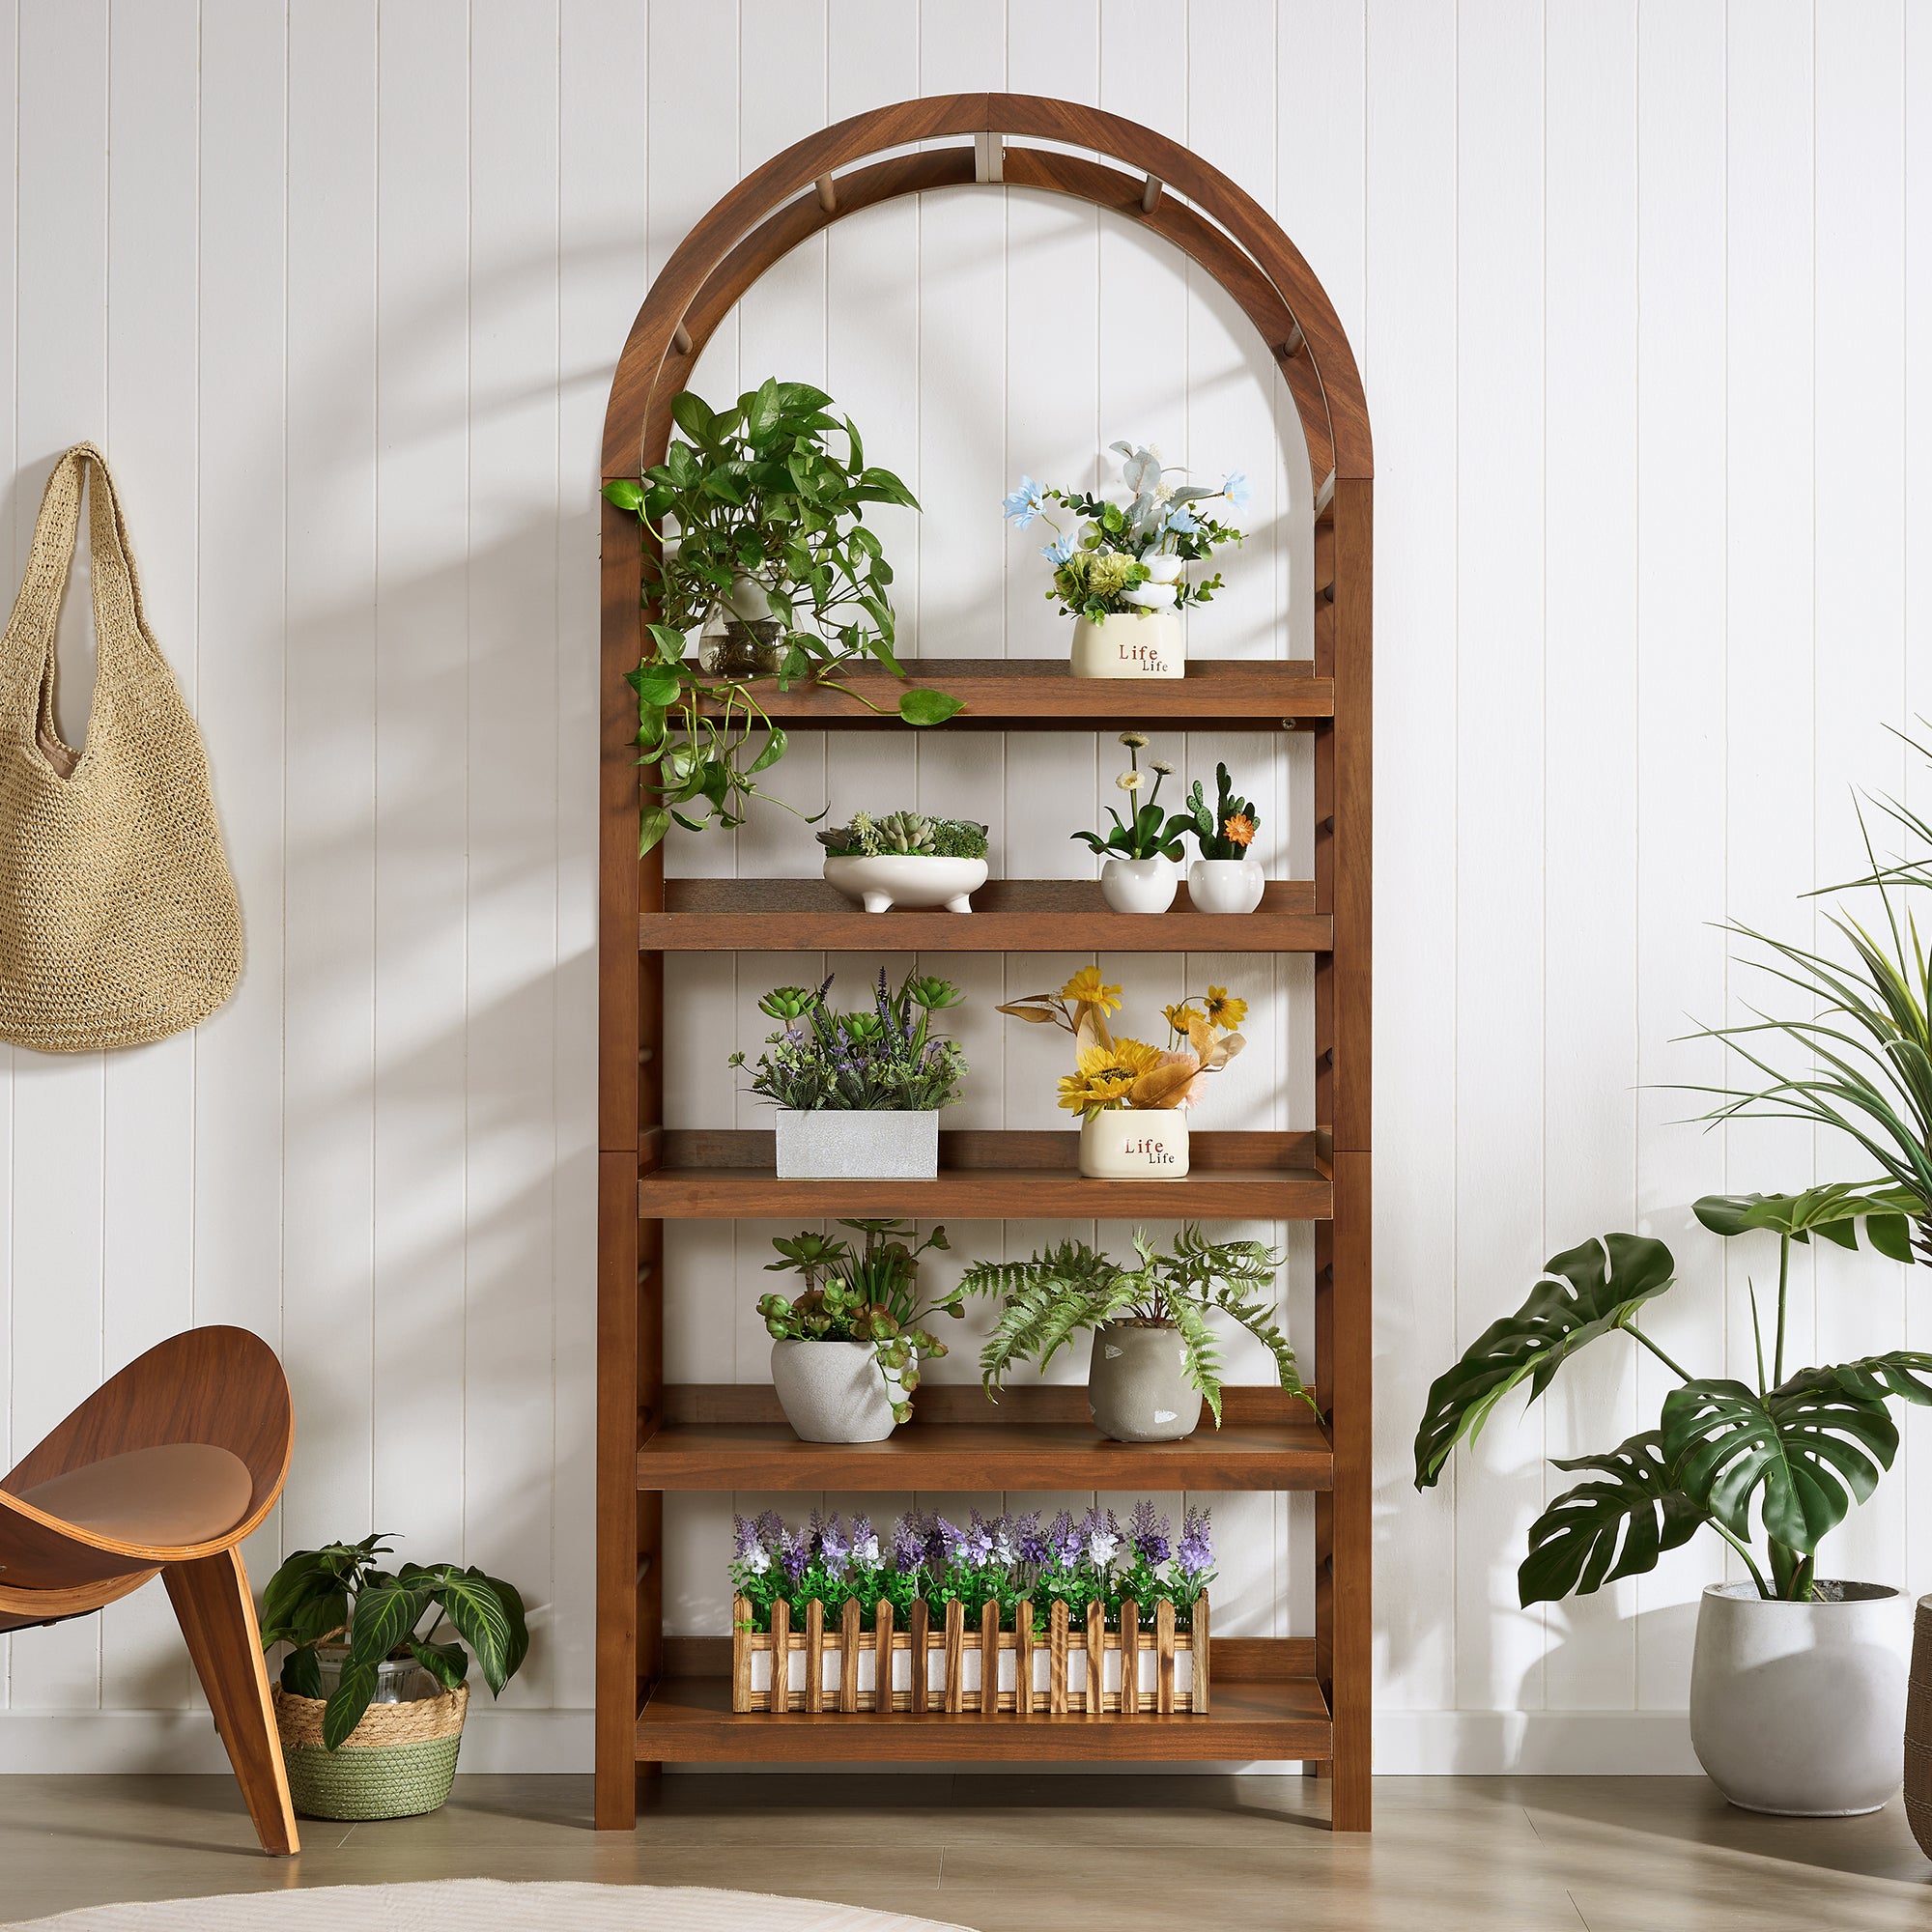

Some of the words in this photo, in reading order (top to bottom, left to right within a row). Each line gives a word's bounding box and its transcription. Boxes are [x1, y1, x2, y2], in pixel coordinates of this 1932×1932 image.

[1119, 644, 1158, 661] Life
[1142, 660, 1169, 672] Life
[1124, 1138, 1164, 1154] Life
[1149, 1152, 1175, 1164] Life
